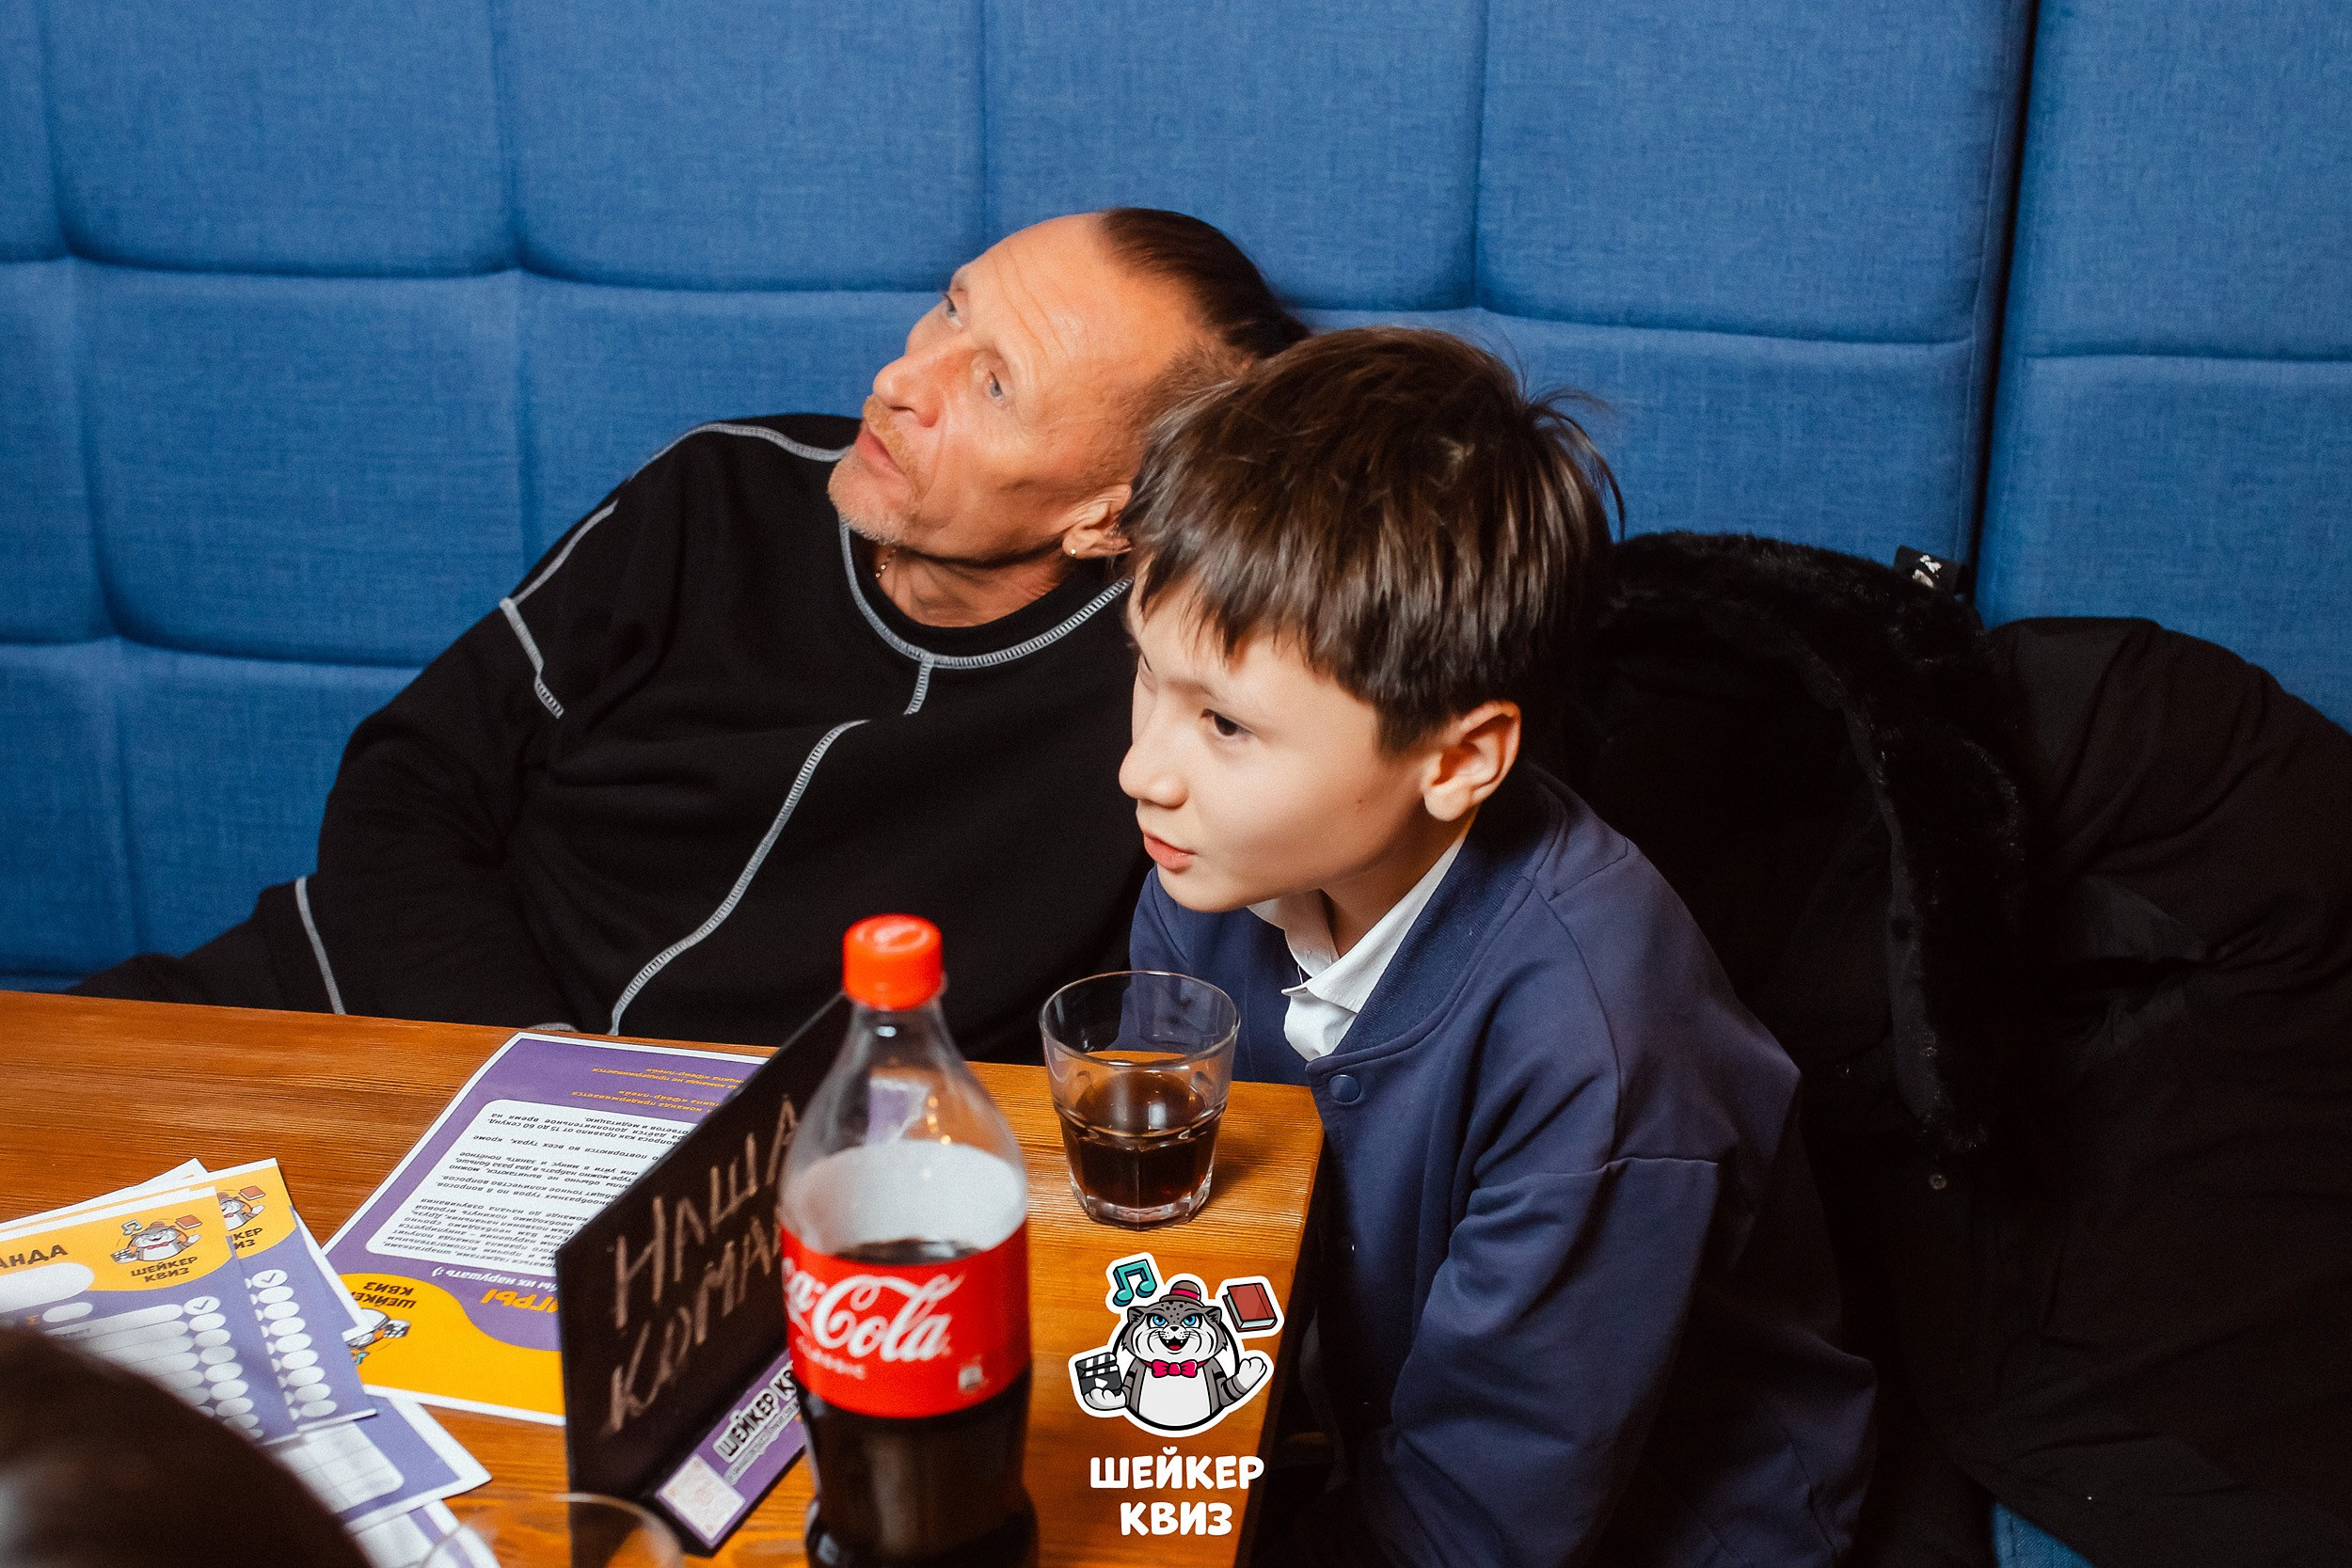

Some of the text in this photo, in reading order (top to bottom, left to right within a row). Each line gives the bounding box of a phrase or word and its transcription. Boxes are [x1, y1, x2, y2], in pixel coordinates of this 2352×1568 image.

[684, 1078, 725, 1087] команда
[657, 1101, 702, 1112] команда
[544, 1118, 627, 1132] дополнительное
[581, 1117, 640, 1128] медитацию.
[575, 1129, 616, 1137] правило
[649, 1126, 689, 1135] ответов
[584, 1148, 647, 1159] повторяются
[455, 1157, 490, 1166] больше,
[485, 1167, 542, 1179] вычитаются,
[441, 1175, 489, 1184] вопросов.
[490, 1180, 547, 1190] количество
[564, 1177, 600, 1185] обычно
[436, 1181, 484, 1191] вопросов.
[421, 1198, 484, 1209] озвучивания
[404, 1216, 441, 1225] срочно
[415, 1204, 573, 1226] необходимо покинуть игровой
[444, 1213, 499, 1225] начальник,
[545, 1212, 588, 1221] команде
[447, 1222, 511, 1233] необходимо
[500, 1222, 548, 1230] позвонил
[231, 1227, 262, 1243] КЕР
[391, 1229, 434, 1238] получит
[437, 1235, 481, 1243] команда
[479, 1233, 536, 1243] нарушении
[383, 1241, 451, 1254] шпаргалками,
[387, 1236, 477, 1250] вспомогательным
[485, 1241, 528, 1249] правила
[454, 1250, 509, 1261] гаджетами,
[483, 1248, 522, 1257] прочим
[131, 1256, 198, 1277] ШЕЙКЕР
[144, 1267, 190, 1283] КВИЗ
[445, 1269, 516, 1285] нарушать
[363, 1281, 413, 1295] КВИЗ
[351, 1291, 416, 1308] ШЕЙКЕ
[718, 1392, 775, 1457] ШЕЙКЕР
